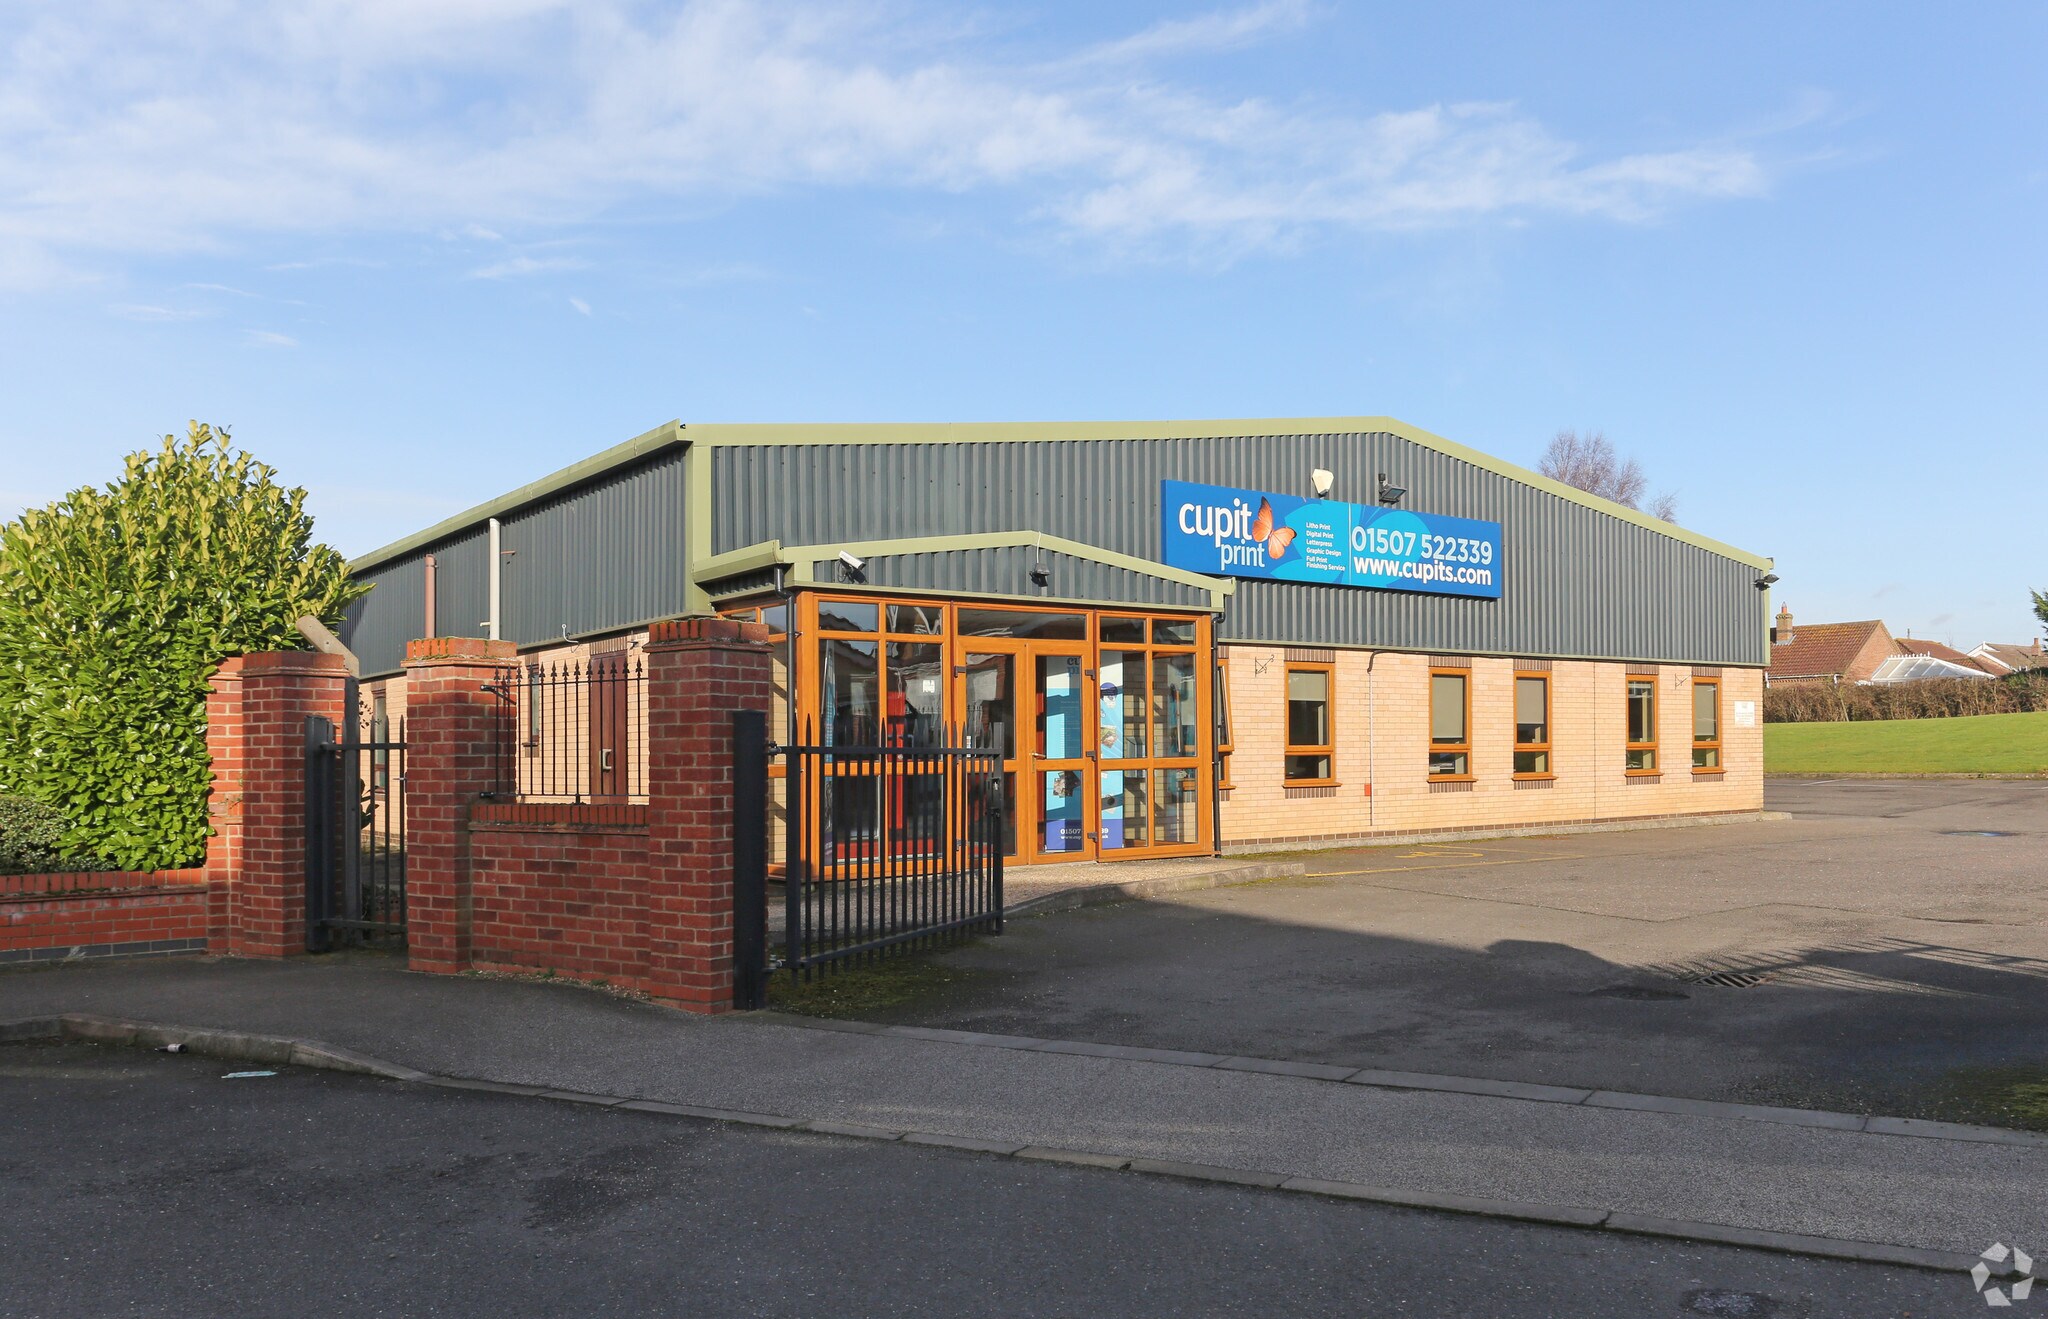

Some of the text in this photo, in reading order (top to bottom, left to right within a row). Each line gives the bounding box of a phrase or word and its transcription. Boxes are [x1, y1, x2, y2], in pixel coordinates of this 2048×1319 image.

[1179, 498, 1253, 548] cupit
[1306, 530, 1322, 538] Digital
[1306, 539, 1333, 547] Letterpress
[1220, 538, 1265, 571] print
[1306, 547, 1342, 557] Graphic Design
[1352, 526, 1492, 565] 01507 522339
[1306, 562, 1328, 570] Finishing
[1354, 556, 1492, 586] www.cupits.com
